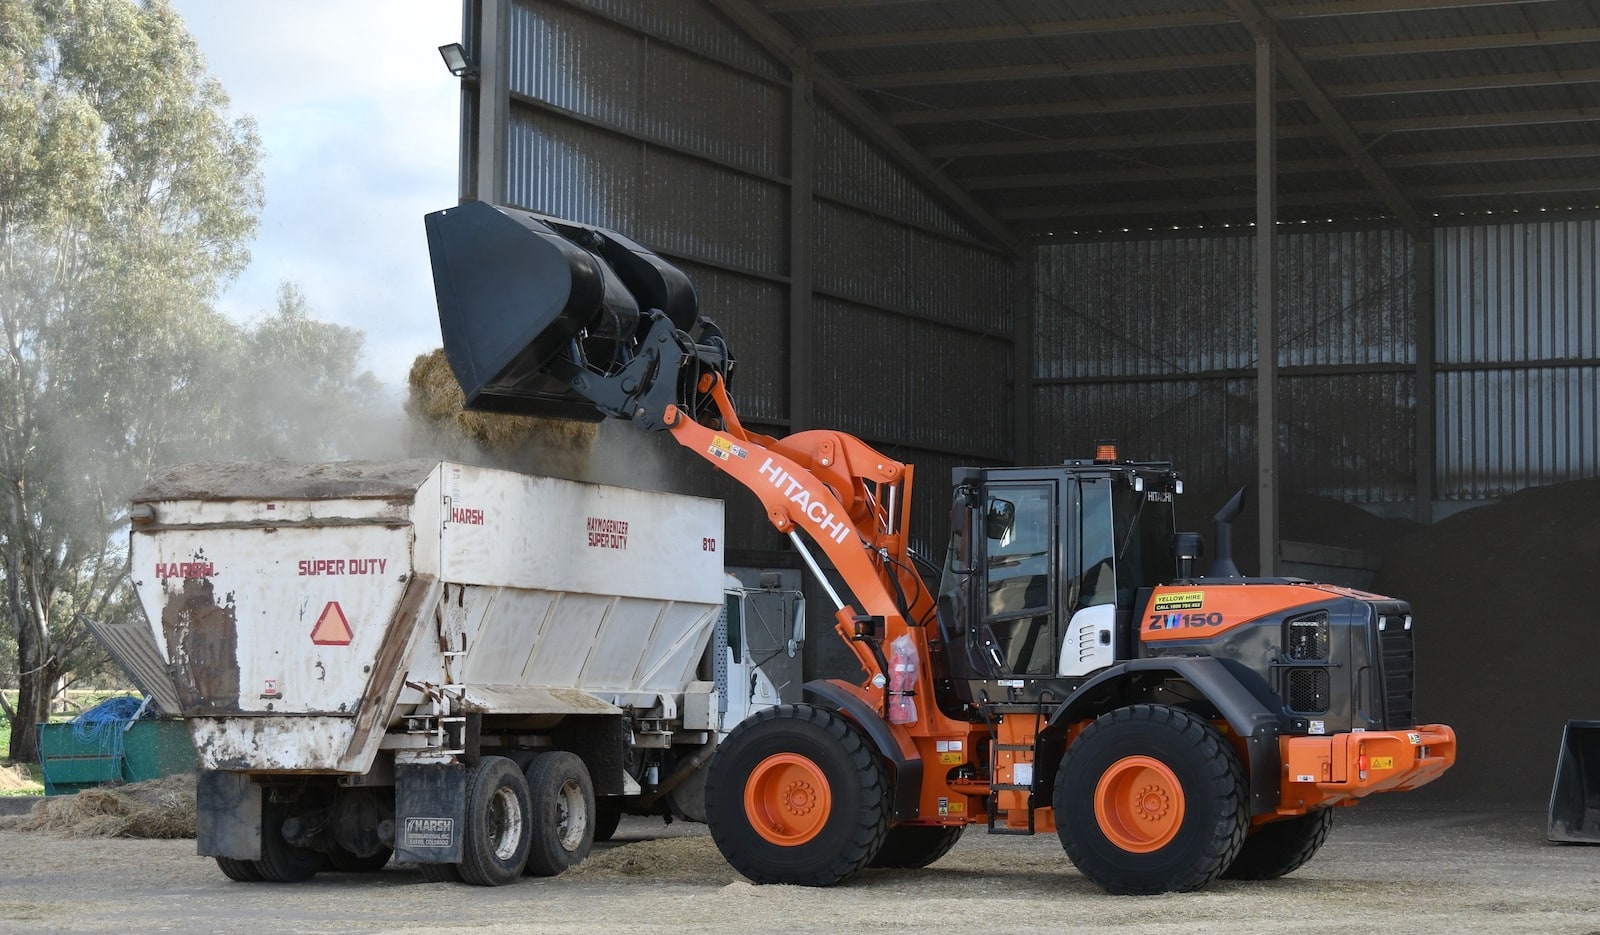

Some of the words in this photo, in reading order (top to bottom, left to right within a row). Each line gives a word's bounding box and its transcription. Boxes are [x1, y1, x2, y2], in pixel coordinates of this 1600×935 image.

[759, 457, 850, 544] HITACHI
[1147, 491, 1172, 502] HITACHI
[452, 507, 484, 525] HARSH
[587, 517, 628, 535] HAYMOGENIZER
[588, 532, 609, 548] SUPER
[611, 534, 627, 550] DUTY
[703, 538, 715, 552] 810
[156, 562, 213, 578] HARSH
[299, 560, 345, 576] SUPER
[349, 559, 387, 574] DUTY
[1149, 612, 1223, 630] ZW150
[415, 820, 451, 832] HARSH
